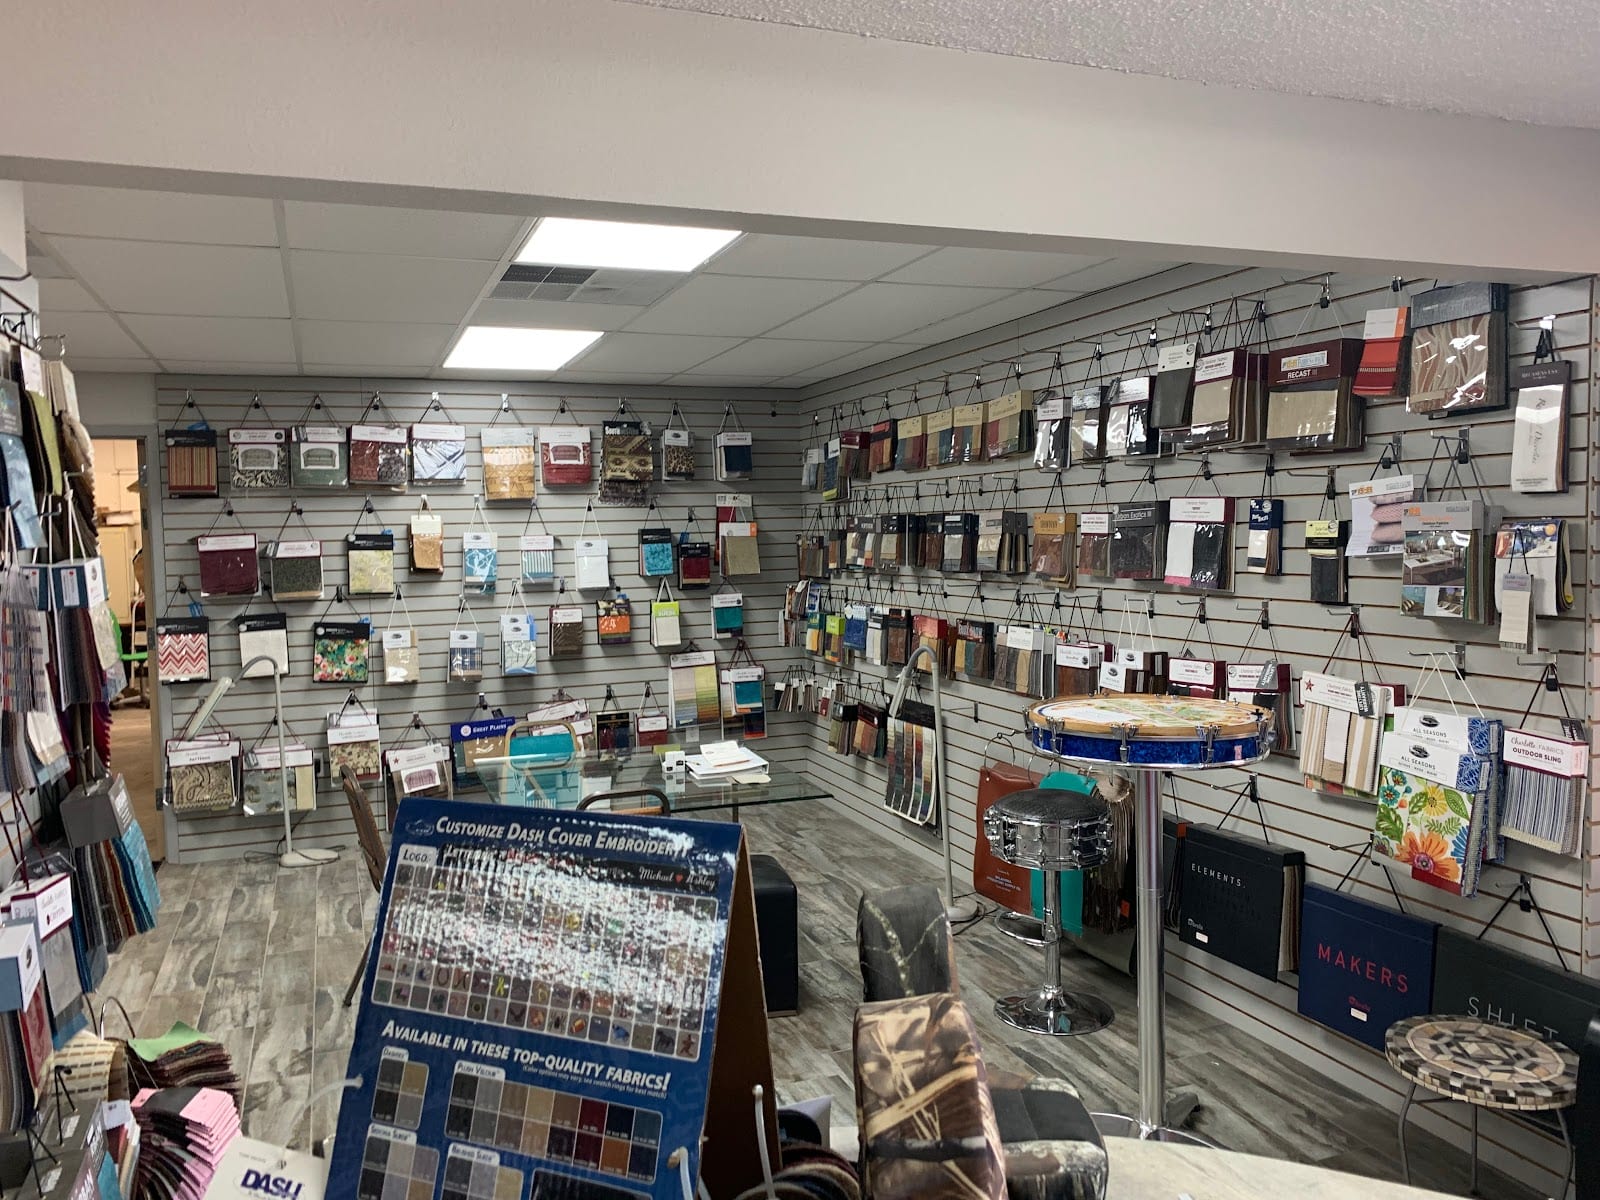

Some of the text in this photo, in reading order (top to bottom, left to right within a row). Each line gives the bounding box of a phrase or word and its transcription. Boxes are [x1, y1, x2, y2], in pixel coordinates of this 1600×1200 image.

[1288, 369, 1311, 379] RECAST
[1411, 758, 1436, 770] SEASONS
[1512, 747, 1562, 763] OUTDOOR SLING
[436, 816, 505, 838] CUSTOMIZE
[507, 822, 545, 843] DASH
[548, 827, 592, 846] COVER
[639, 866, 673, 882] Michael
[1318, 943, 1408, 993] MAKERS
[1467, 996, 1559, 1039] SHIFT
[381, 1019, 671, 1091] AVAILABLE IN THESE TOP-QUALITY FABRICS!
